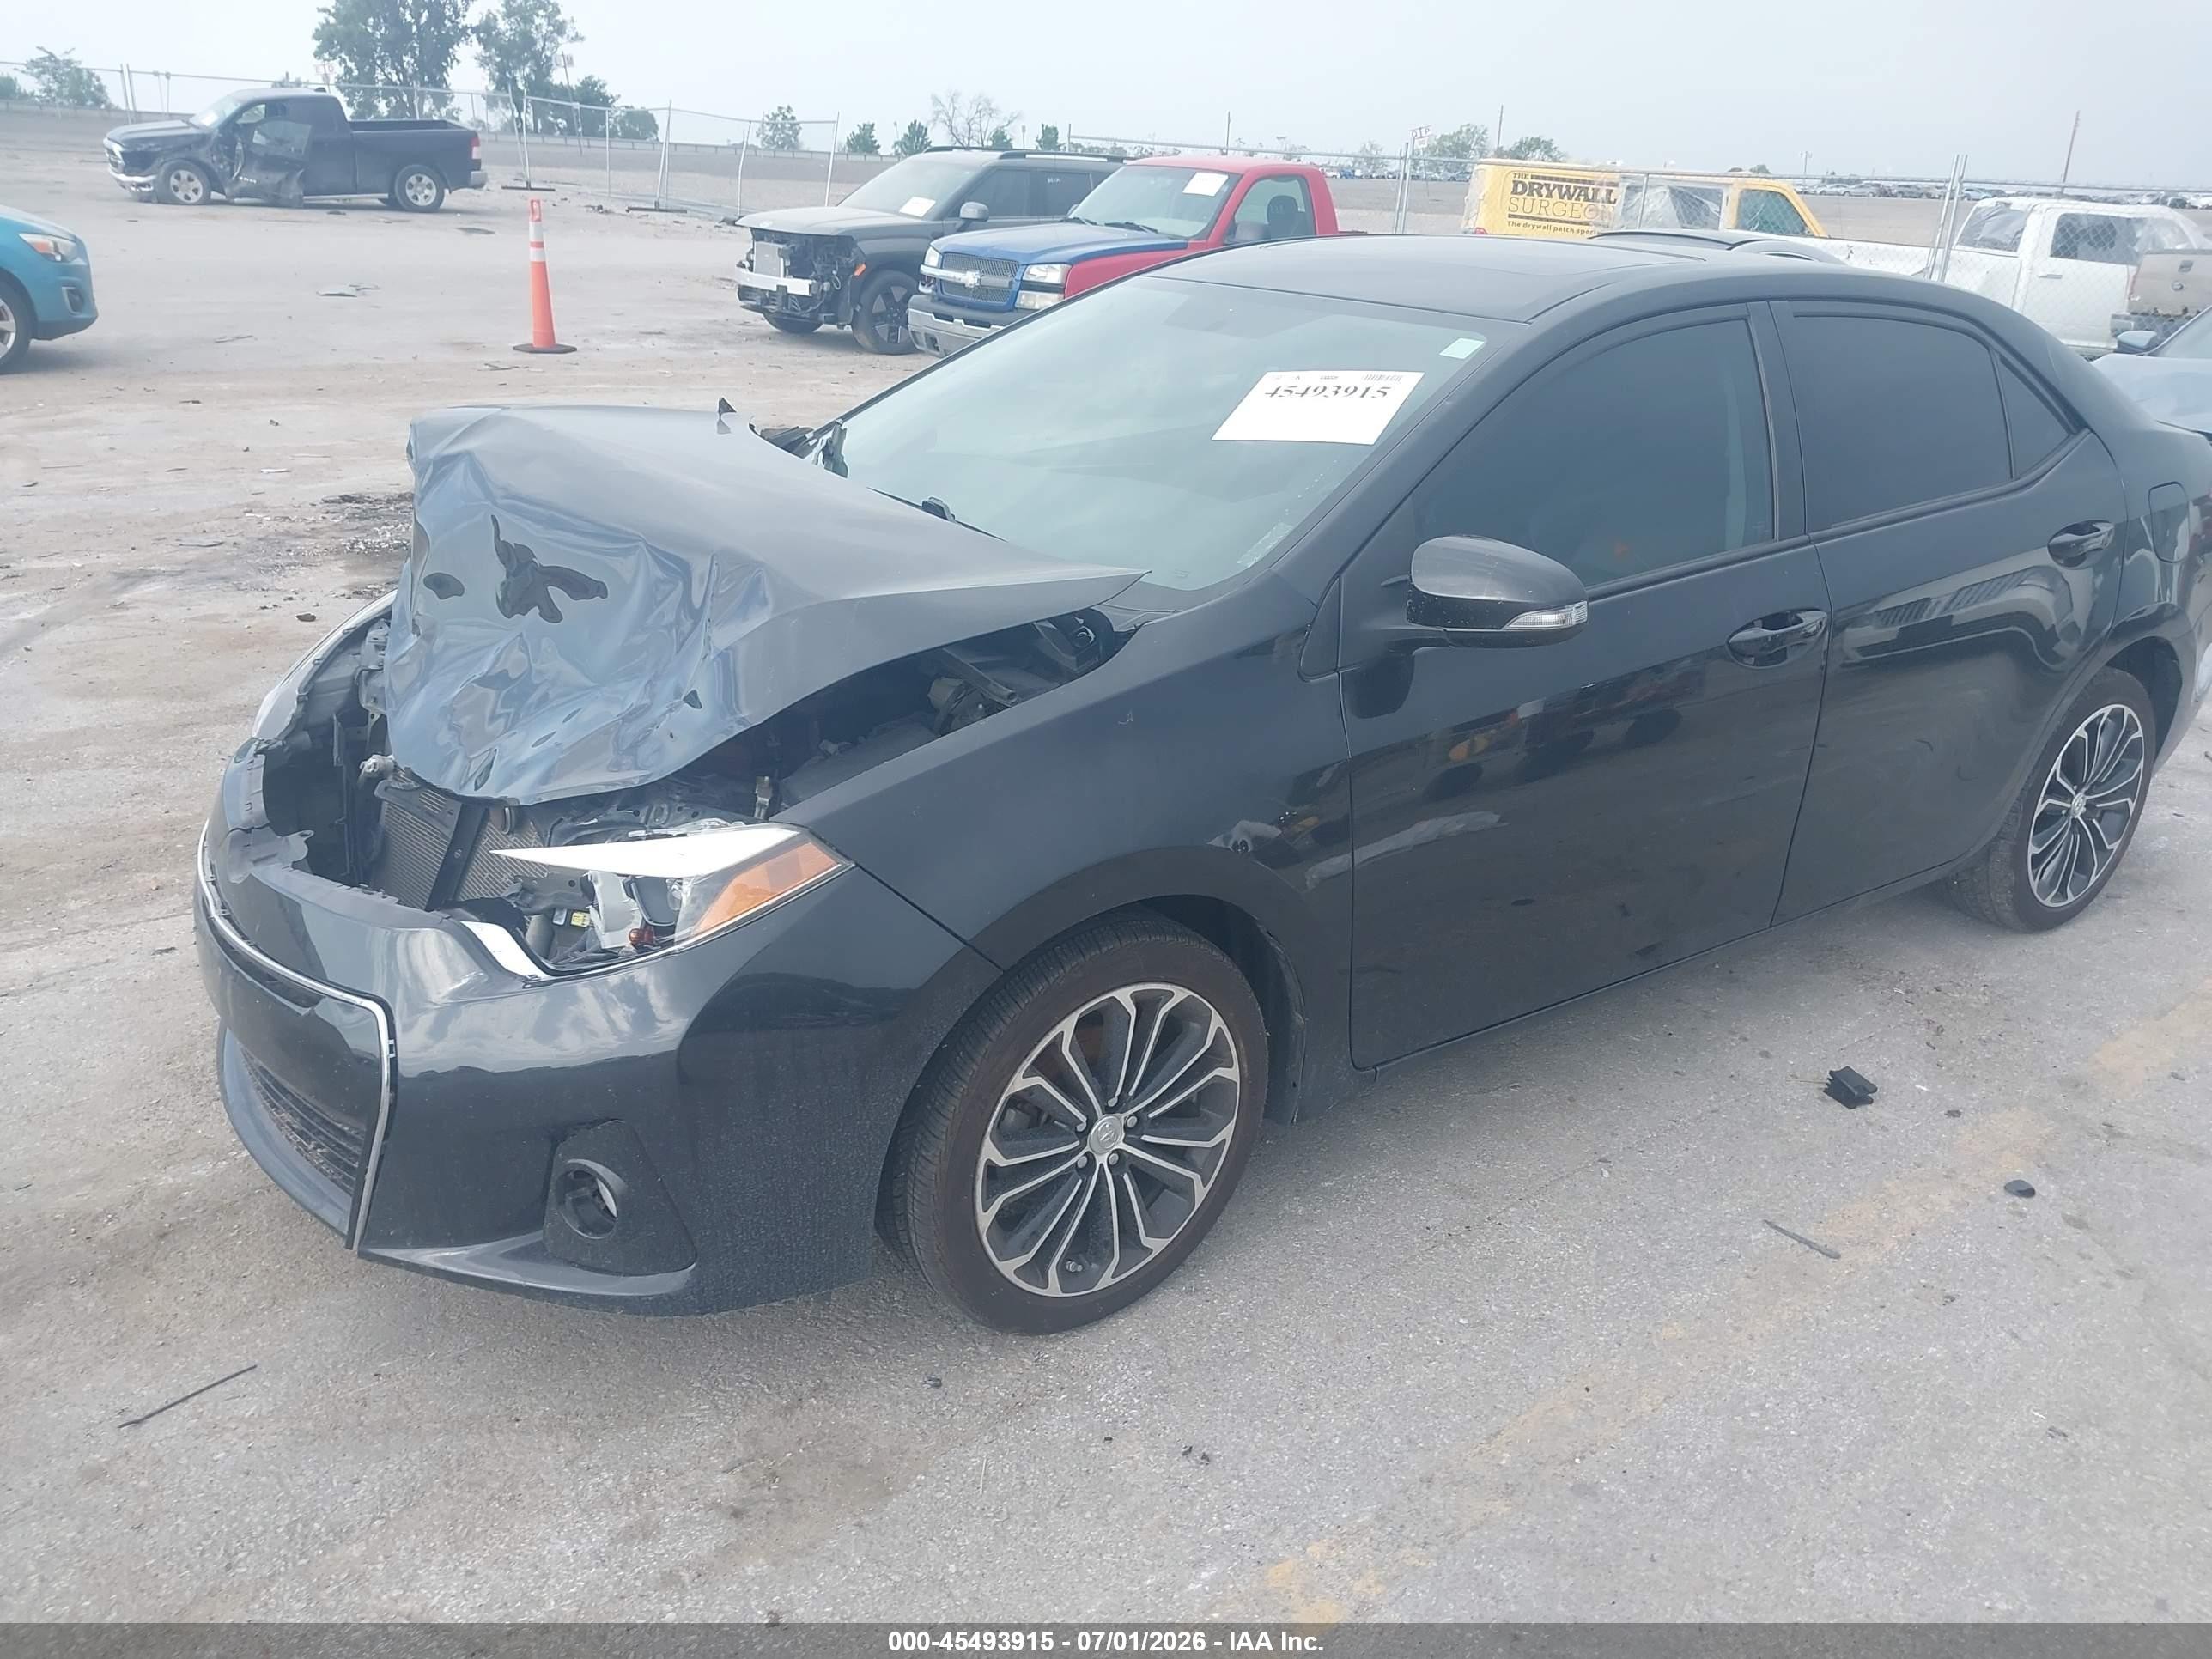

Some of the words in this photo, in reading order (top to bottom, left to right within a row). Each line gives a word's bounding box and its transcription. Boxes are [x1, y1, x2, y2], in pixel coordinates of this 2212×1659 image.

[1511, 179, 1617, 204] DRYWALL
[1522, 222, 1552, 231] drywall
[1553, 226, 1575, 234] patch
[1265, 386, 1391, 398] 45493915
